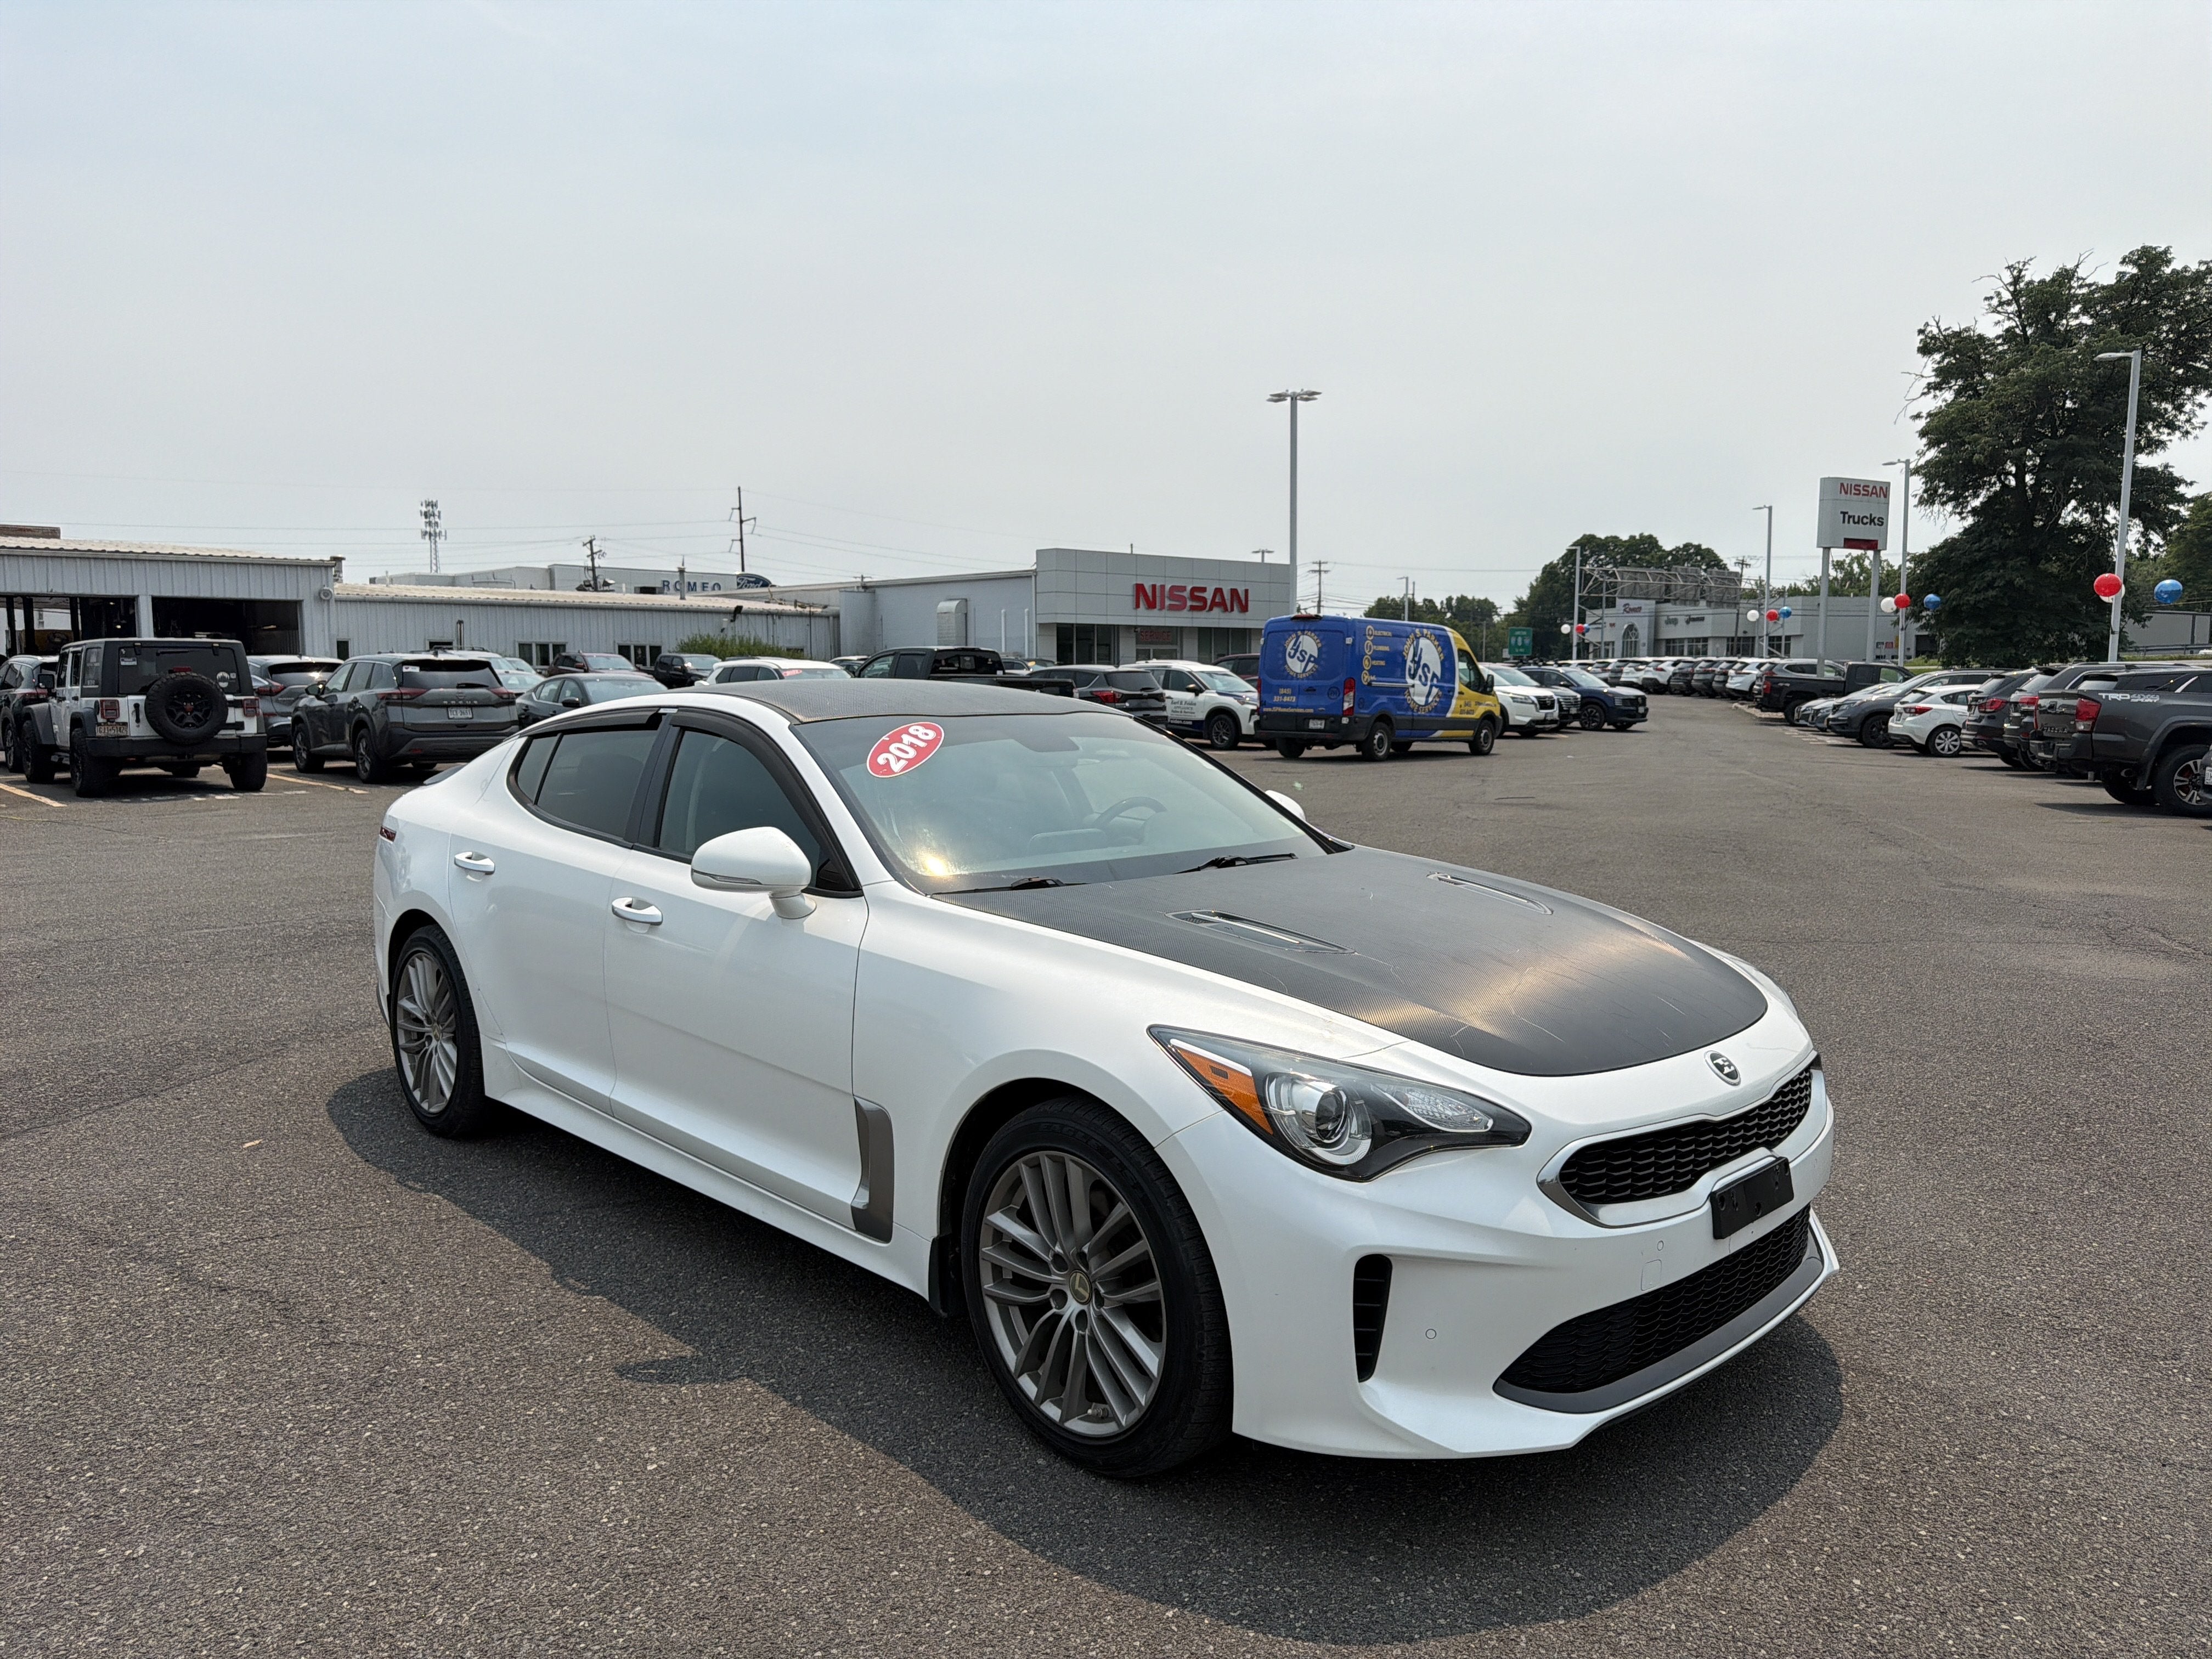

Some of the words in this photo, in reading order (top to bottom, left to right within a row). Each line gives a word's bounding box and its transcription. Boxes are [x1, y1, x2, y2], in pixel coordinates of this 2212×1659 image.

[1839, 482, 1888, 499] NISSAN
[1840, 511, 1884, 527] Trucks
[662, 580, 721, 591] ROMEO
[737, 577, 763, 589] Ford
[1134, 583, 1249, 613] NISSAN
[1140, 632, 1171, 641] SERVICE
[1284, 633, 1296, 648] JOHN
[1403, 633, 1415, 660] JOHN
[1423, 629, 1444, 662] PARKER
[2098, 693, 2130, 701] TRD
[877, 725, 936, 773] 2018
